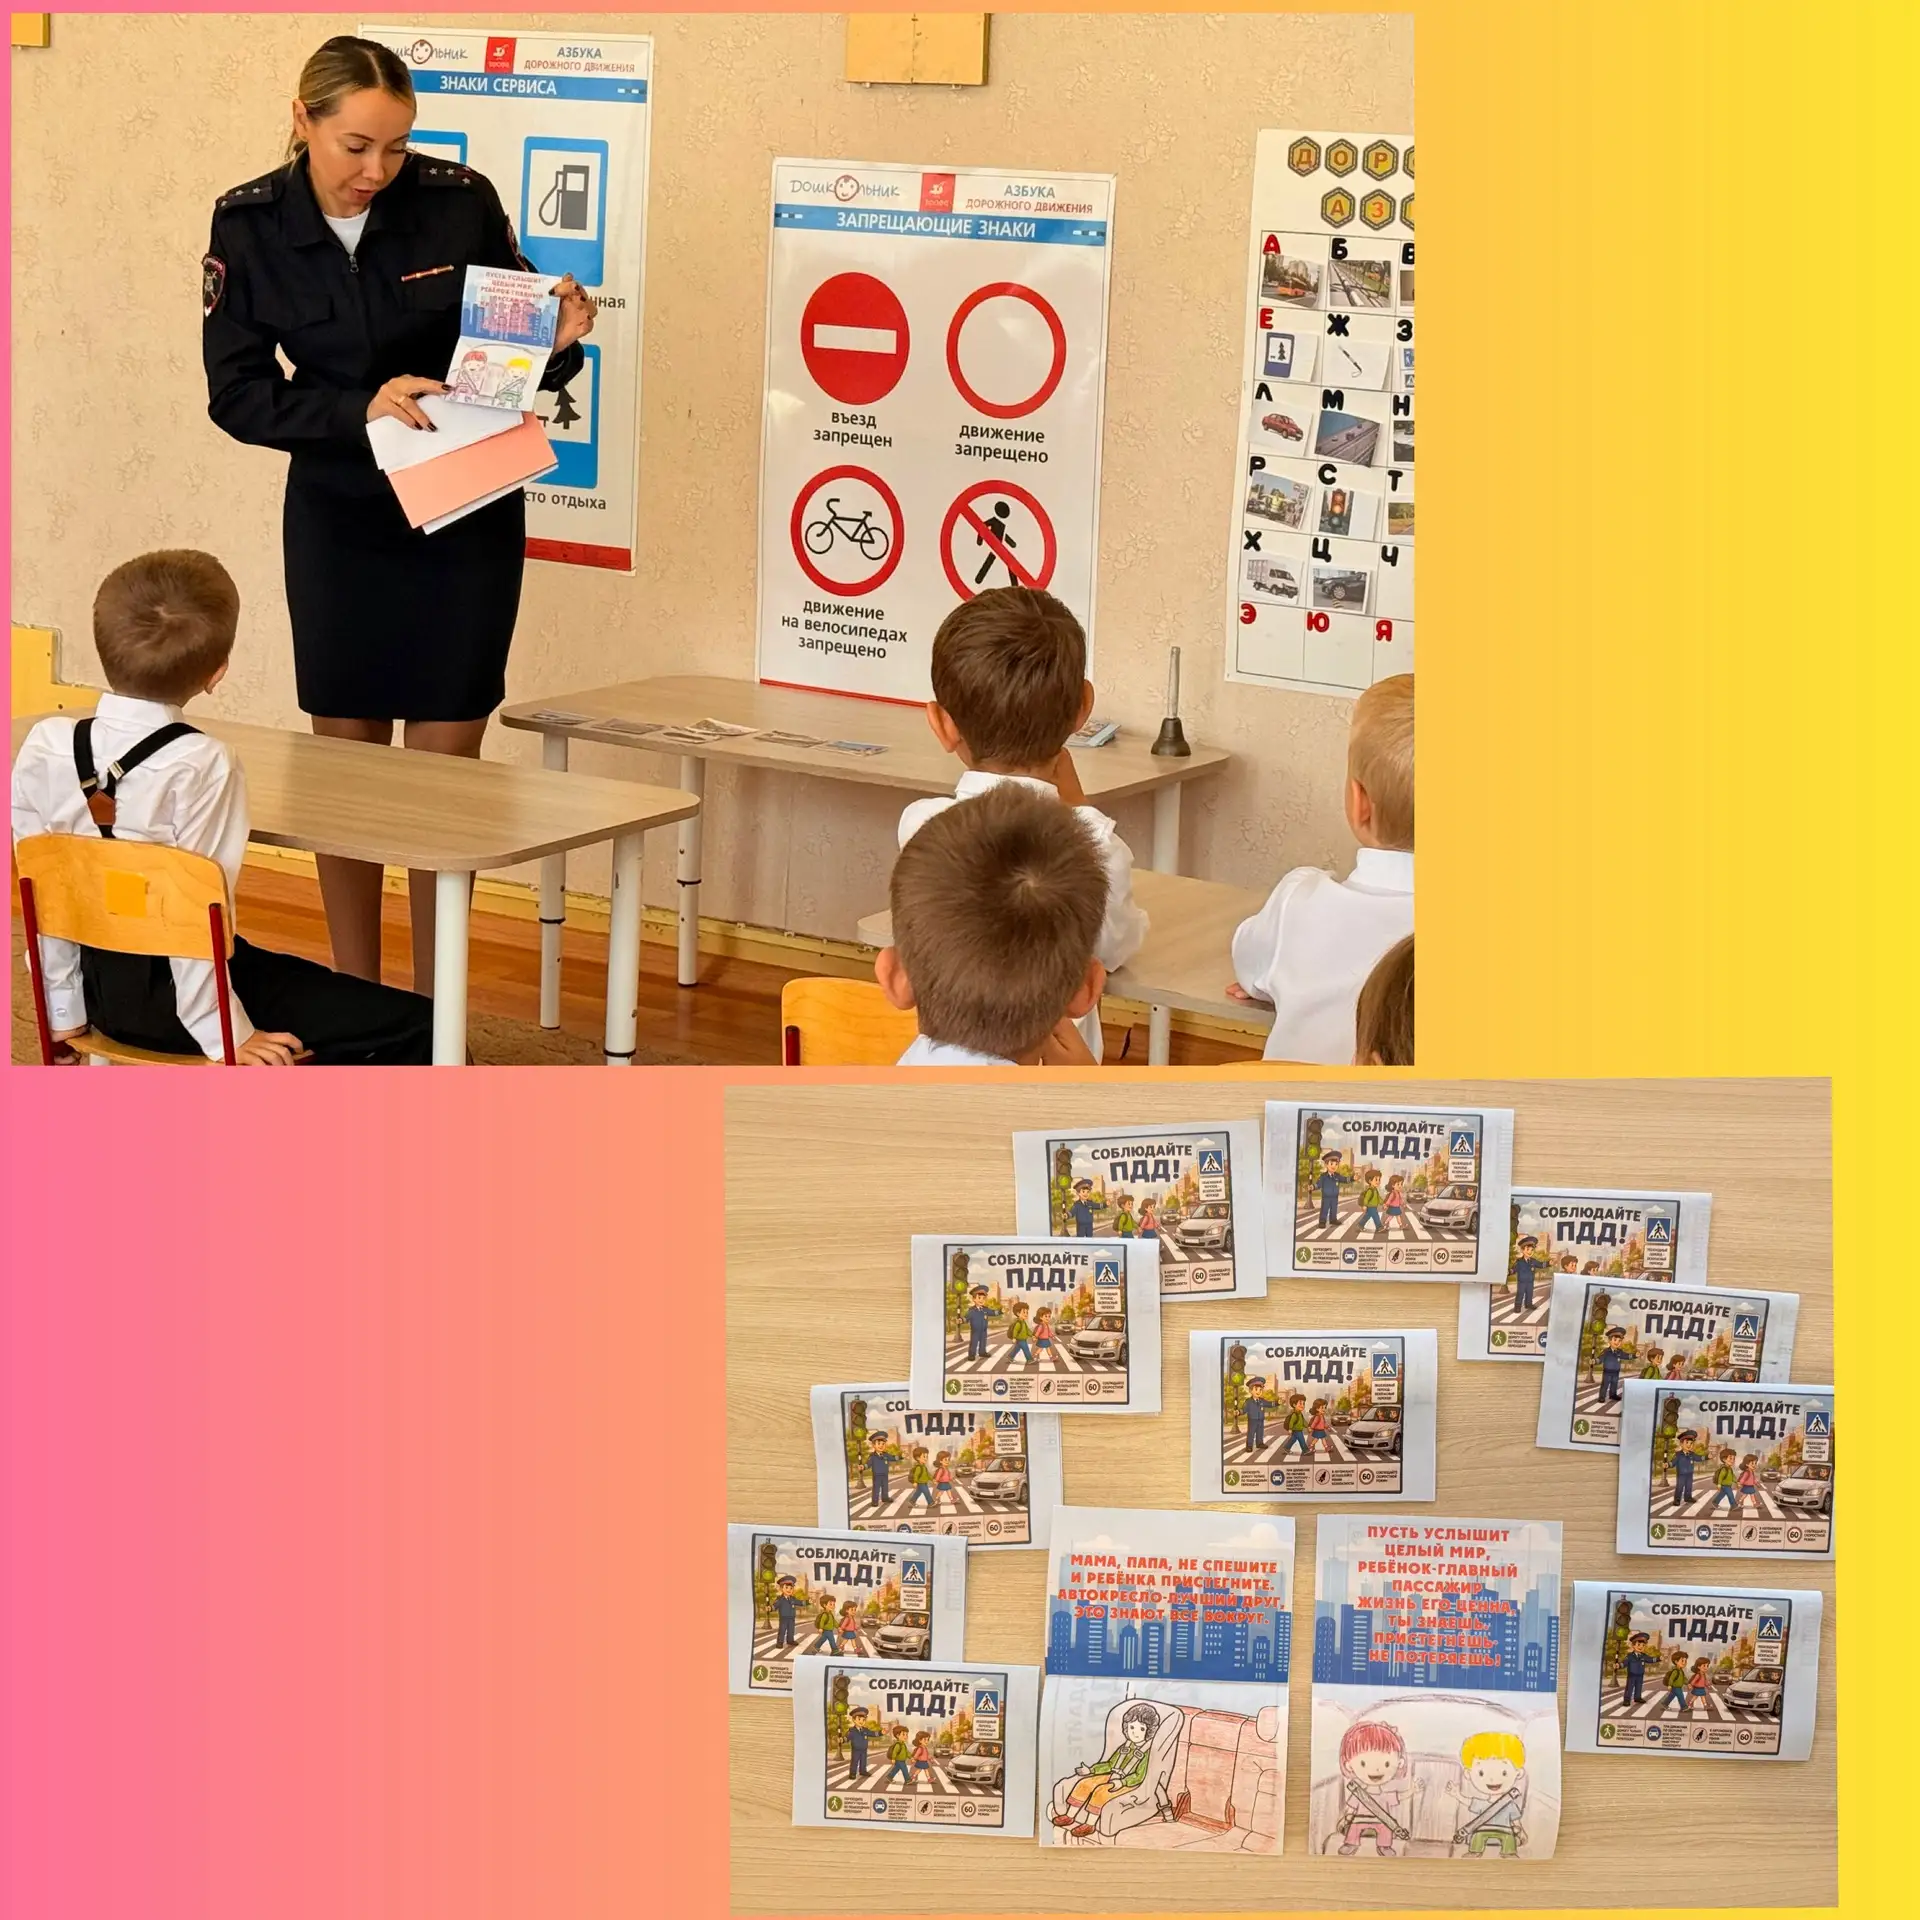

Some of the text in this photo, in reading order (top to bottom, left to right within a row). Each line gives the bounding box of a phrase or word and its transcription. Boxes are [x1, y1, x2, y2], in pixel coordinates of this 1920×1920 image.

[558, 47, 601, 58] АЗБУКА
[524, 60, 634, 72] ДОРОЖНОГО ДВИЖЕНИЯ
[440, 76, 556, 95] ЗНАКИ СЕРВИСА
[1004, 185, 1055, 199] АЗБУКА
[966, 199, 1093, 214] ДОРОЖНОГО ДВИЖЕНИЯ
[837, 212, 1035, 238] ЗАПРЕЩАЮЩИЕ ЗНАКИ
[1263, 234, 1280, 254] А
[1331, 238, 1348, 260] Б
[1259, 308, 1273, 329] Е
[1327, 313, 1350, 337] Ж
[1322, 389, 1344, 410] М
[1393, 395, 1410, 416] Н
[832, 412, 877, 430] въезд
[813, 428, 892, 448] запрещен
[959, 424, 1045, 443] движение
[955, 443, 1049, 464] запрещено
[1249, 456, 1403, 491] Р С Т
[524, 491, 606, 509] сто отдыха
[1244, 530, 1399, 566] Х Ц Ч
[803, 600, 884, 621] движение
[782, 615, 908, 643] на велосипедах
[1240, 603, 1392, 641] Э Ю Я
[799, 636, 886, 659] запрещено
[1342, 1120, 1445, 1135] СОБЛЮДАЙТЕ
[1091, 1143, 1192, 1160] СОБЛЮДАЙТЕ
[1361, 1135, 1431, 1160] ПДД!
[1110, 1160, 1179, 1183] ПДД!
[1540, 1206, 1641, 1222] СОБЛЮДАЙТЕ
[1557, 1221, 1628, 1246] ПДД!
[988, 1252, 1088, 1267] СОБЛЮДАЙТЕ
[1006, 1267, 1075, 1291] ПДД!
[1629, 1298, 1731, 1317] СОБЛЮДАЙТЕ
[1645, 1314, 1716, 1341] ПДД!
[1266, 1345, 1366, 1358] СОБЛЮДАЙТЕ
[1284, 1360, 1354, 1383] ПДД!
[1700, 1400, 1800, 1415] СОБЛЮДАЙТЕ
[905, 1413, 975, 1436] ПДД!
[1716, 1415, 1786, 1440] ПДД!
[1368, 1526, 1510, 1542] ПУСТЬ УСЛЫШИТ
[796, 1547, 896, 1564] СОБЛЮДАЙТЕ
[1385, 1543, 1491, 1560] ЦЕЛЫЙ МИР,
[1070, 1554, 1277, 1574] МАМА, ПАПА, НЕ СПЕШИТЕ
[814, 1562, 883, 1587] ПДД!
[1071, 1571, 1275, 1591] И РЕБЁНКА ПРИСТЕГНИТЕ.
[1392, 1580, 1482, 1594] ПАССАЖИР
[1358, 1596, 1516, 1615] ЖИЗНЬ ЕГО ЦЕННА,
[1652, 1604, 1753, 1620] СОБЛЮДАЙТЕ
[1074, 1607, 1269, 1625] ЭТО ЗНАЮТ ВСЕ ВОКРУГ.
[1388, 1616, 1411, 1627] ТЫ
[1669, 1619, 1739, 1643] ПДД!
[1369, 1650, 1501, 1667] НЕ ПОТЕРЯЕШЬ!
[869, 1679, 969, 1694] СОБЛЮДАЙТЕ
[886, 1693, 956, 1717] ПДД!
